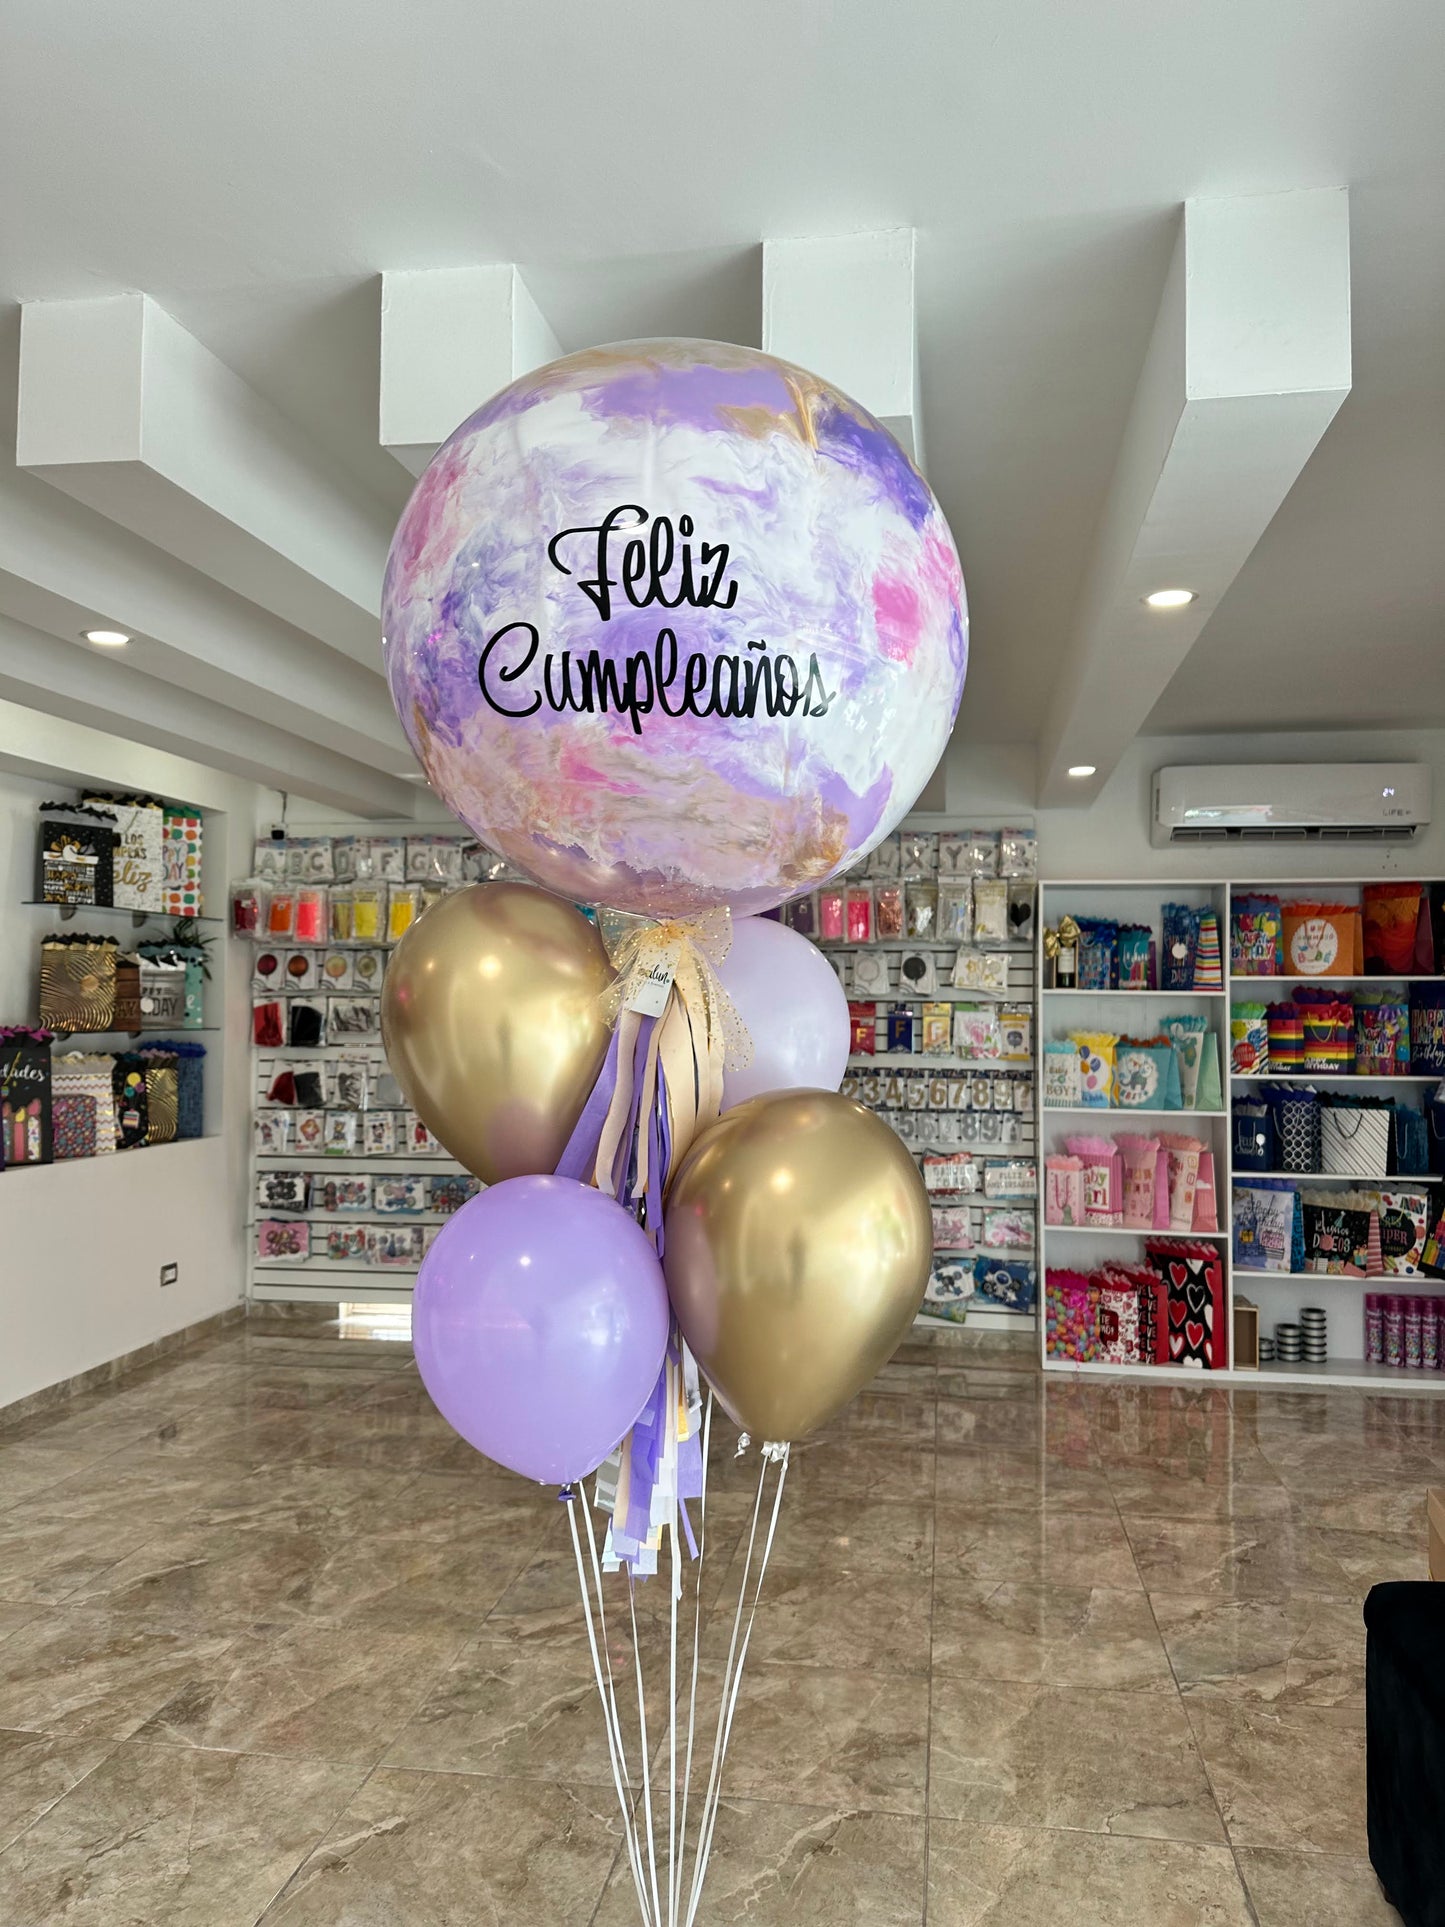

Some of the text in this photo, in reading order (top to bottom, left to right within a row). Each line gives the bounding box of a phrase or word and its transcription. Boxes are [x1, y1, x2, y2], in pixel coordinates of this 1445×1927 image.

[548, 504, 738, 621] Feliz
[478, 621, 836, 735] Cumpleaños
[1382, 787, 1395, 798] 24
[125, 834, 144, 846] LOS
[947, 846, 962, 870] Y
[856, 1028, 867, 1044] F
[895, 1020, 906, 1039] F
[931, 1022, 943, 1041] F
[865, 1077, 880, 1103] 3
[886, 1077, 901, 1104] 4
[909, 1079, 925, 1107] 5
[929, 1078, 946, 1106] 6
[949, 1078, 967, 1105] 7
[972, 1079, 989, 1107] 8
[900, 1110, 915, 1136] 5
[961, 1113, 979, 1141] 8
[982, 1113, 999, 1140] 9
[1312, 1233, 1351, 1253] DEOS
